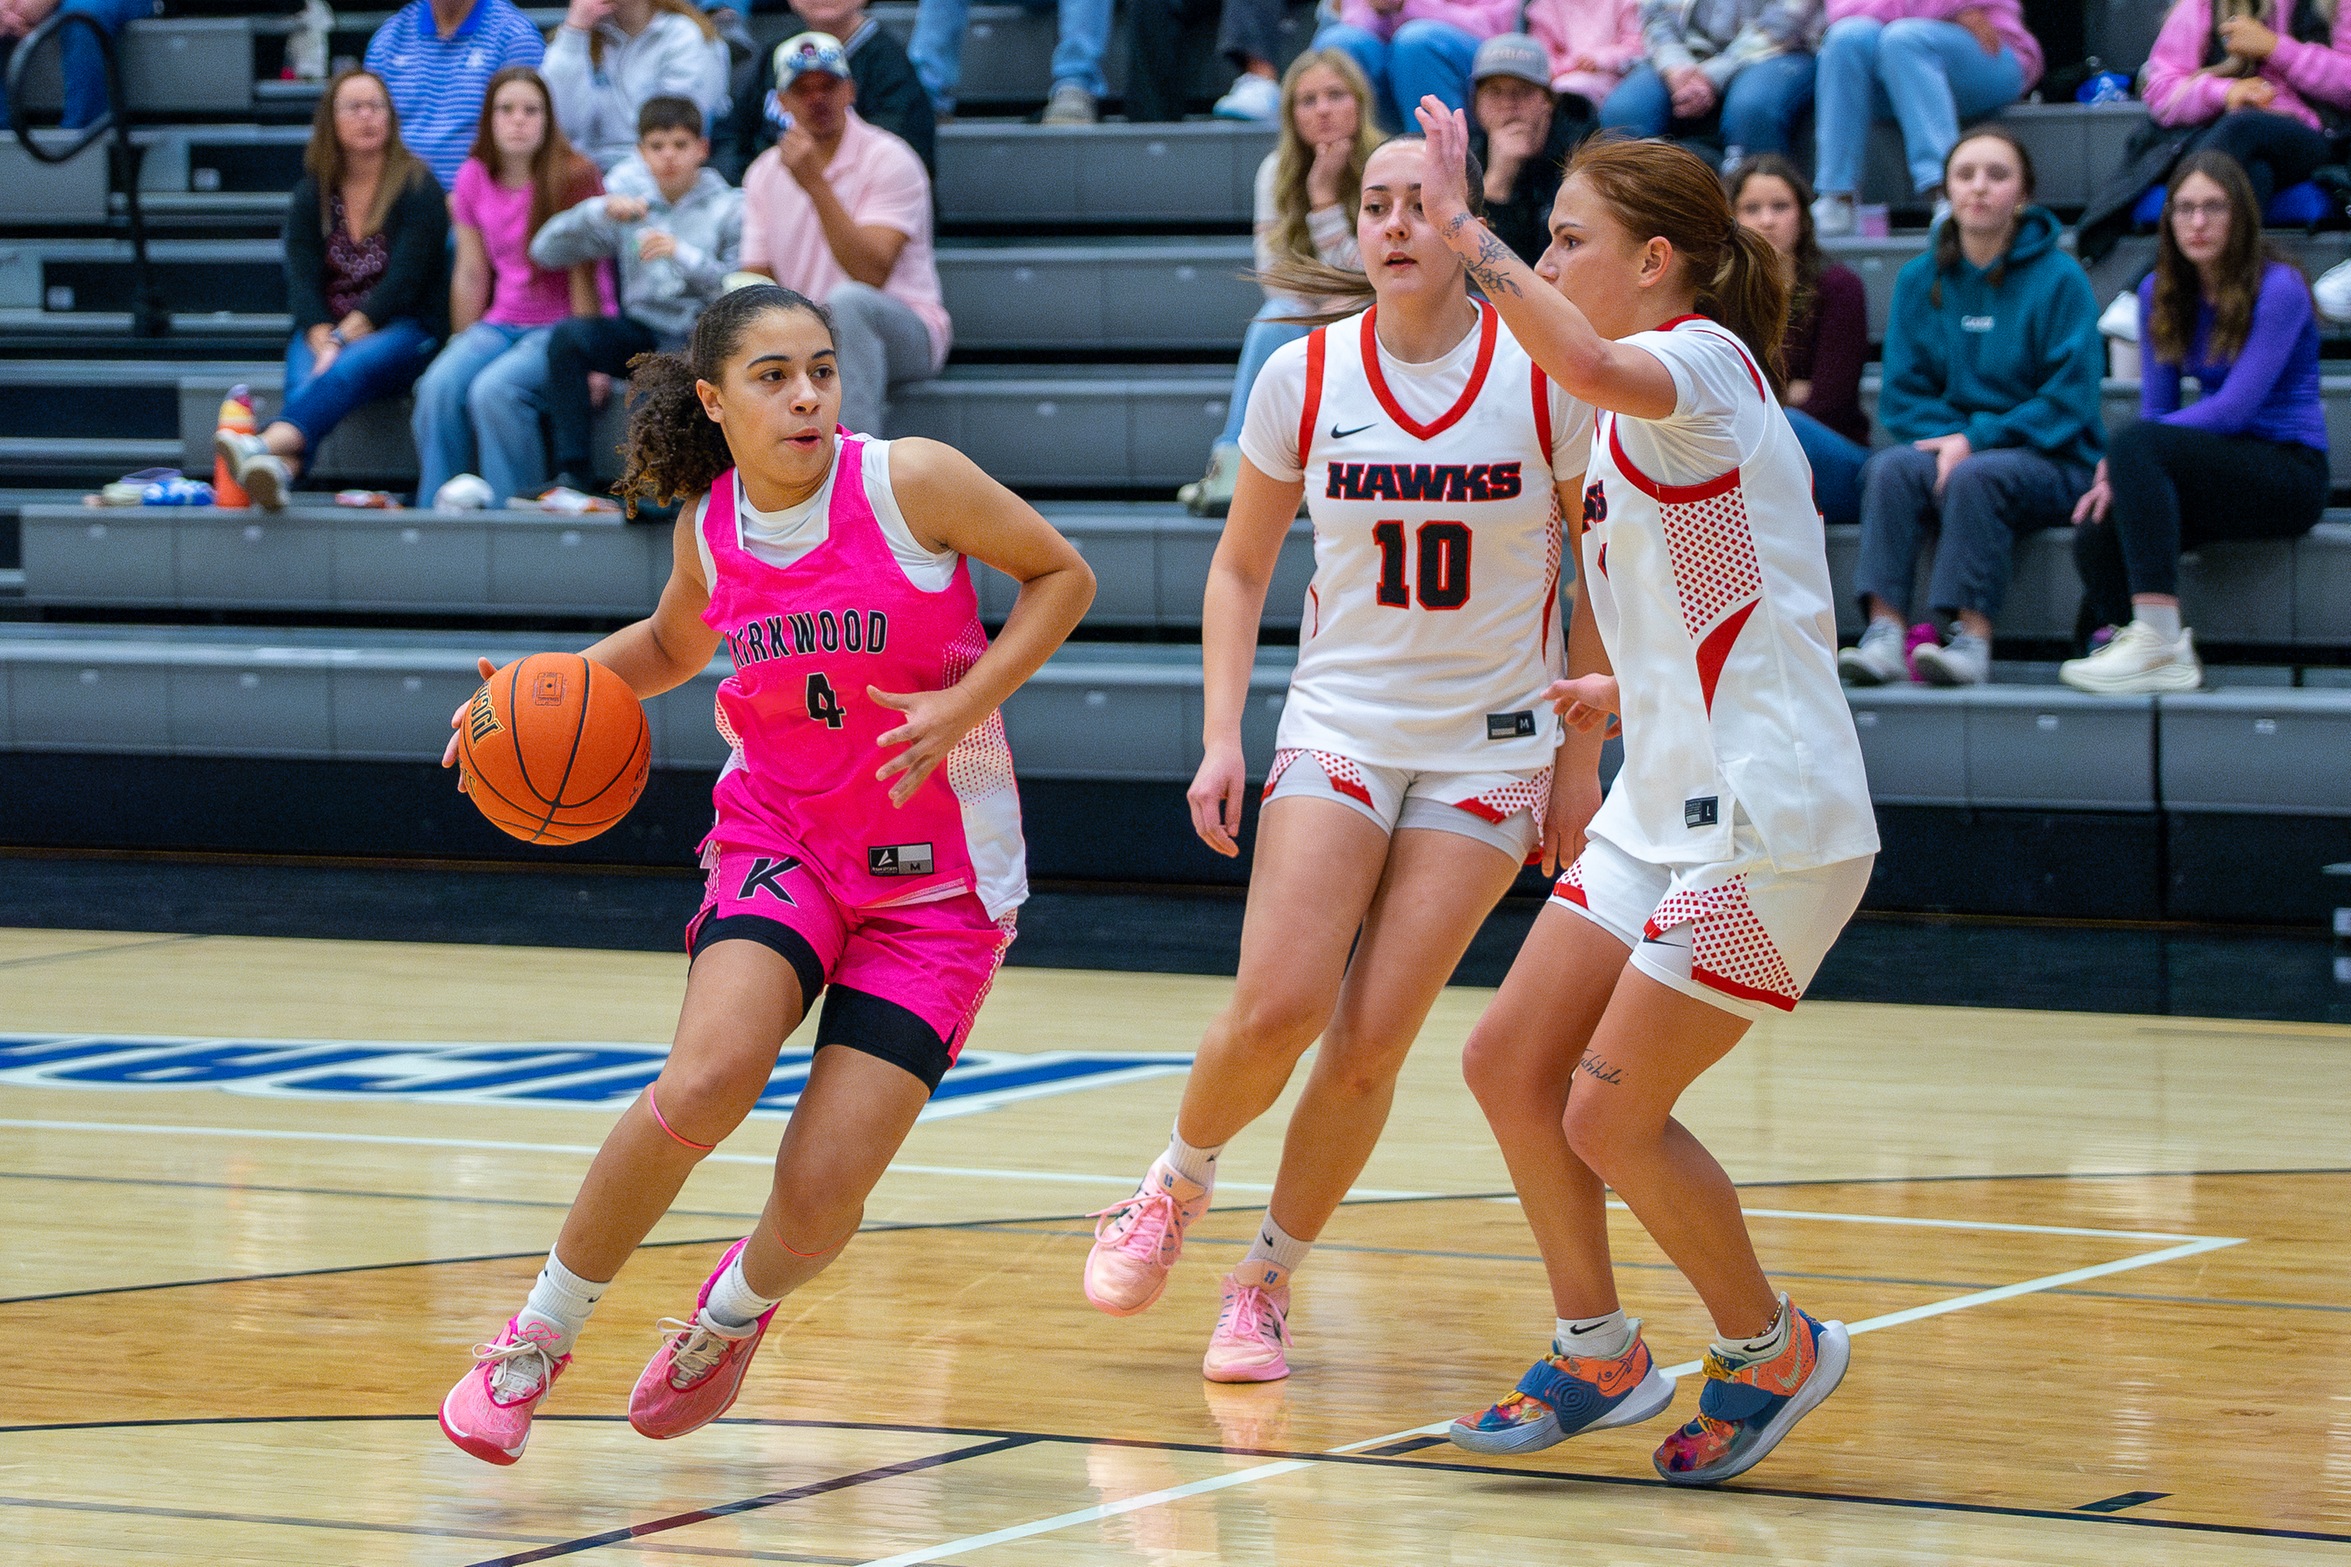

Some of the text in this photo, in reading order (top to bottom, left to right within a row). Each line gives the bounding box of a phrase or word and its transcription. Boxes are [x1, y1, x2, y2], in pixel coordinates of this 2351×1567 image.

[1326, 461, 1522, 502] HAWKS
[1372, 519, 1472, 611] 10
[806, 672, 847, 730] 4
[1706, 805, 1711, 816] L
[736, 856, 802, 908] K
[910, 862, 921, 871] M
